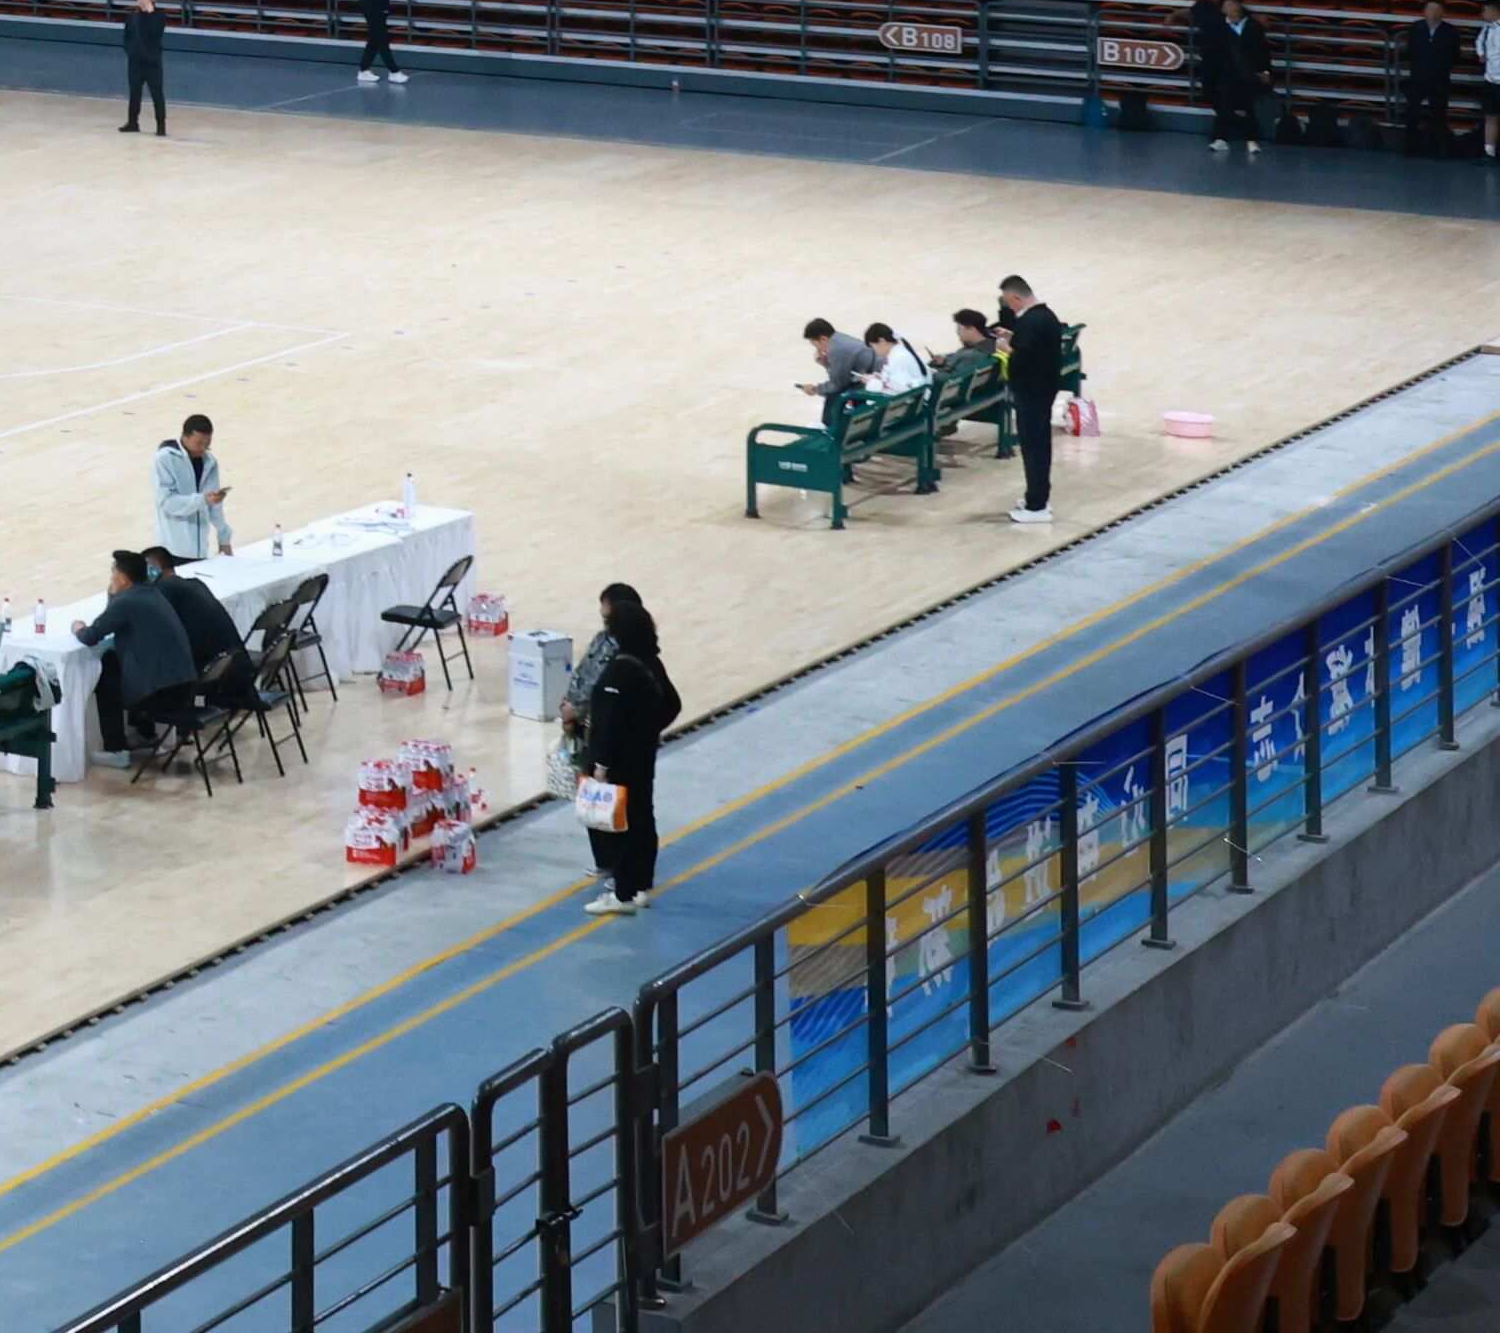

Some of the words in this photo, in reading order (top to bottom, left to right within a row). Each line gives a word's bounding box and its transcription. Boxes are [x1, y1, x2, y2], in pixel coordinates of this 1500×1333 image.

[901, 24, 958, 51] B108
[1102, 38, 1162, 68] B107
[672, 1121, 752, 1239] A202
